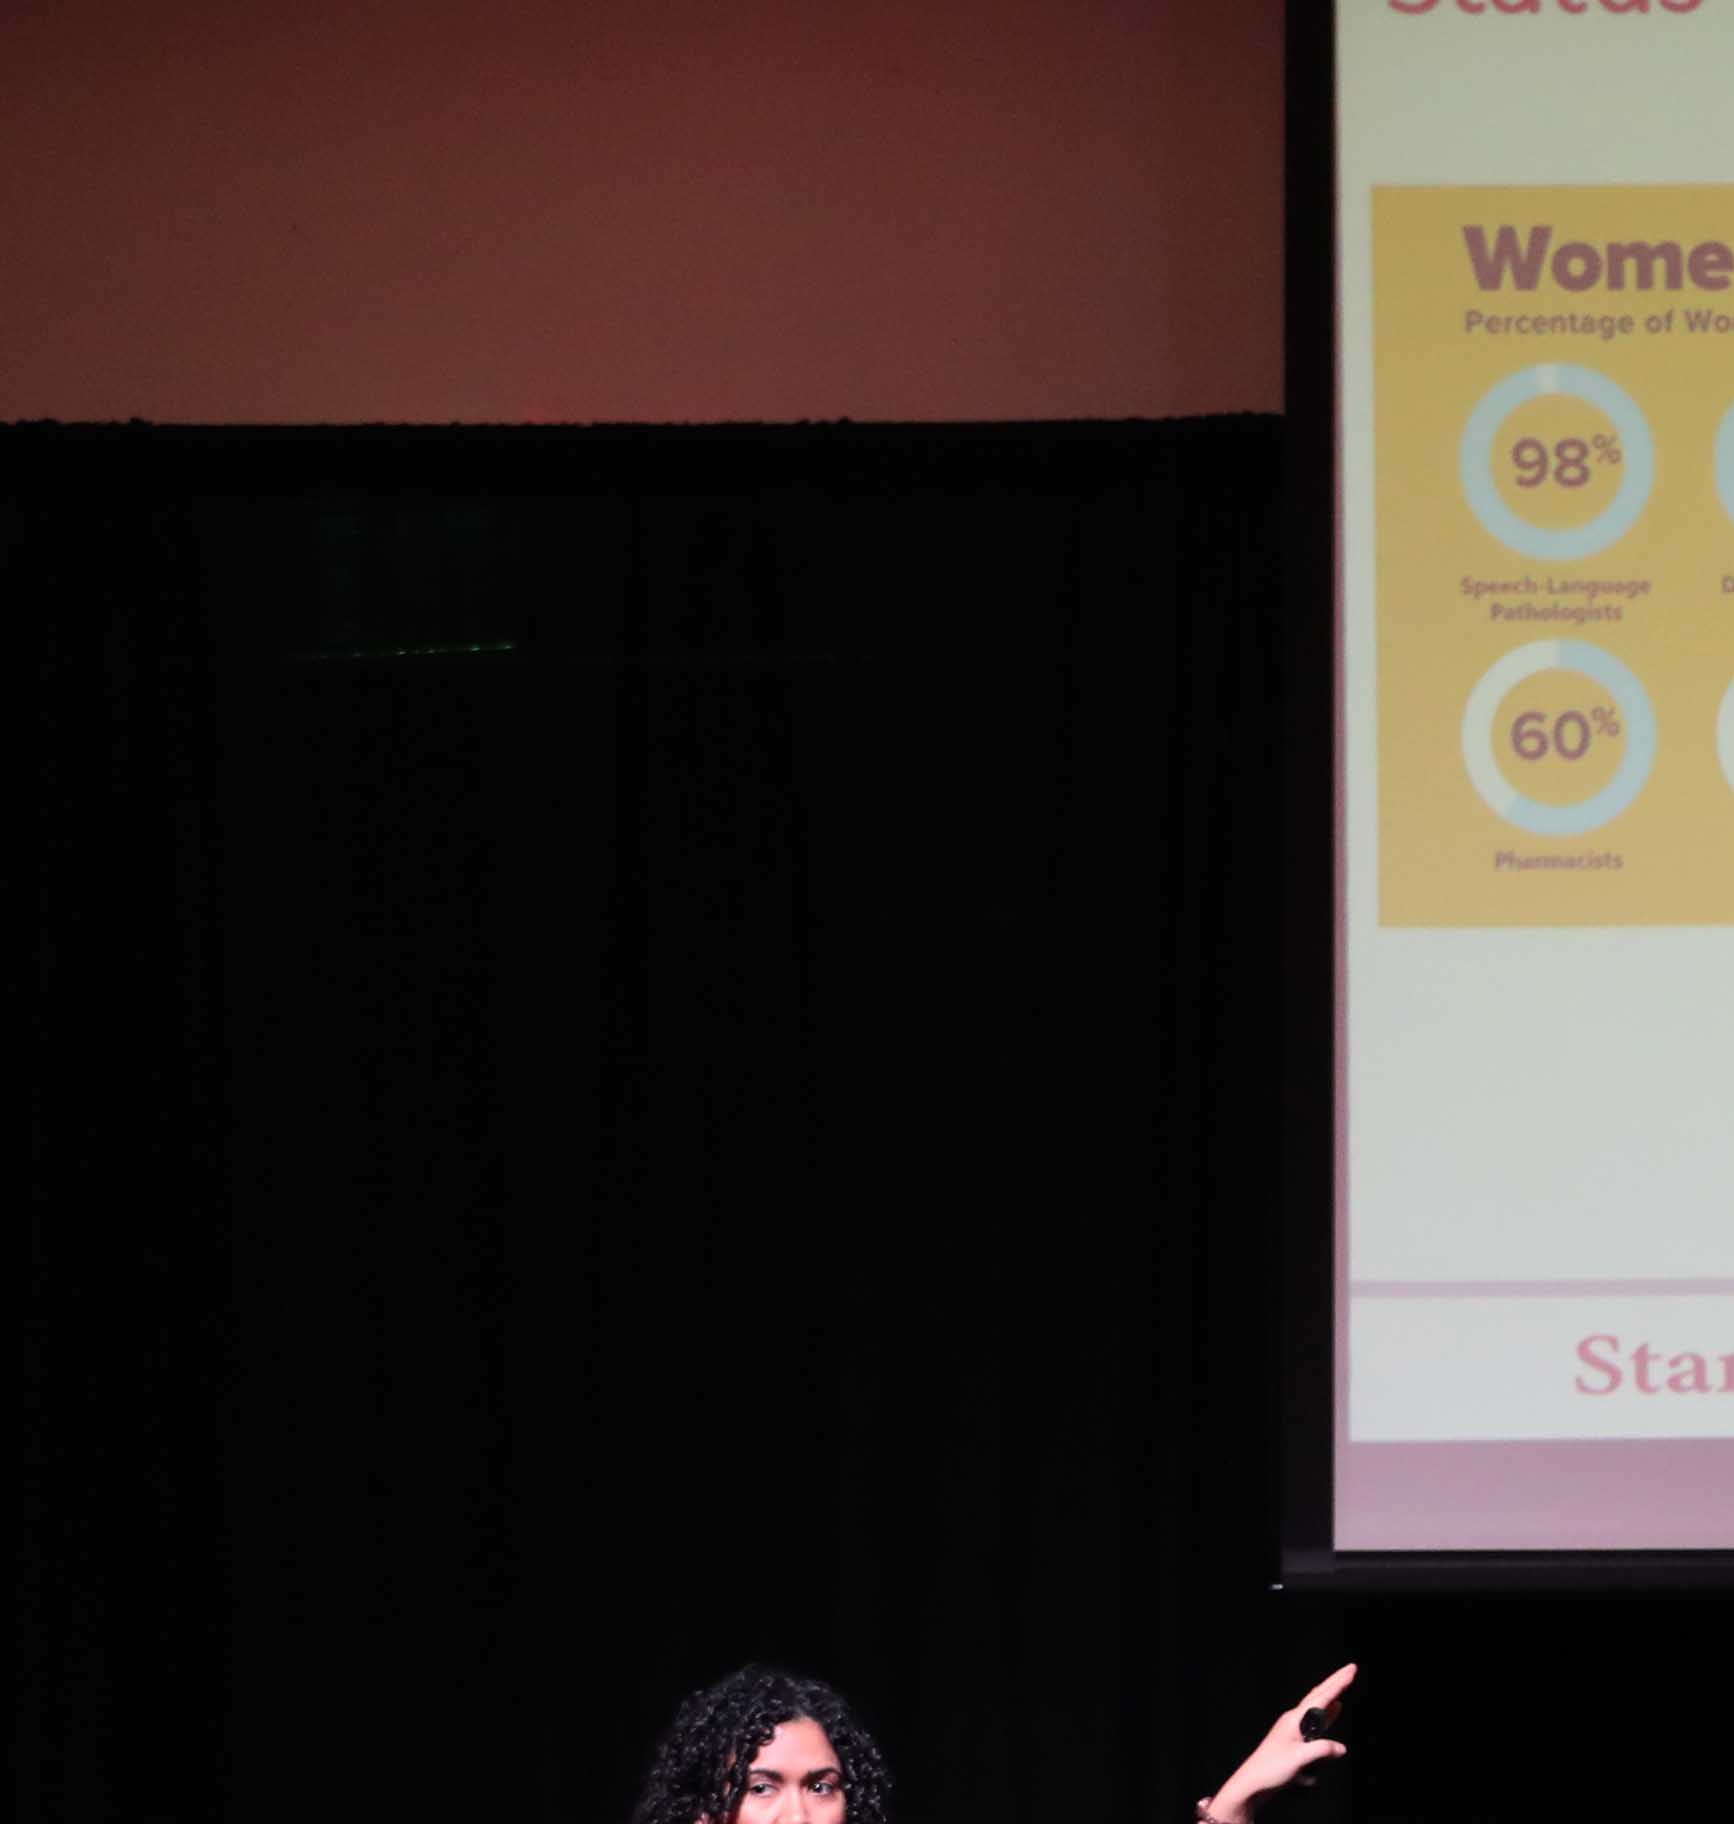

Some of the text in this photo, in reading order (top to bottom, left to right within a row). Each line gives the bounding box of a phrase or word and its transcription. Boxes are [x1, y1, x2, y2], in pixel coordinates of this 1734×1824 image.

[1464, 309, 1635, 340] Percentage
[1646, 309, 1675, 332] of
[1511, 432, 1623, 489] 98%
[1489, 601, 1624, 625] Pathologists
[1509, 704, 1621, 762] 60%
[1494, 849, 1624, 871] Pharmacists
